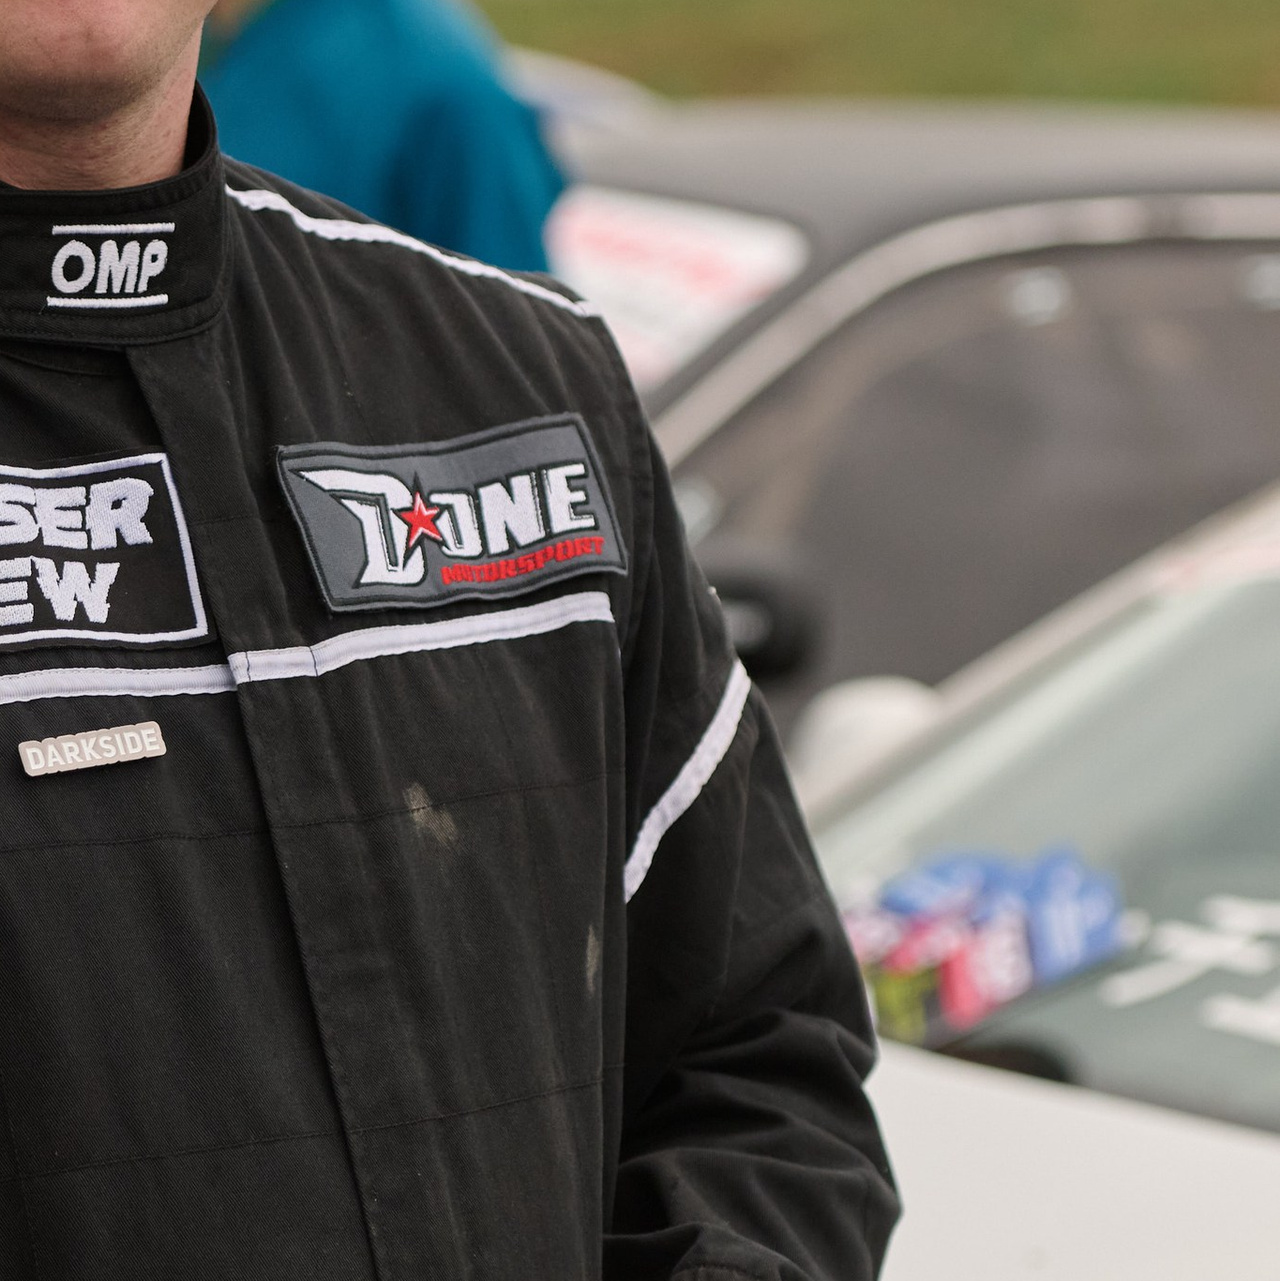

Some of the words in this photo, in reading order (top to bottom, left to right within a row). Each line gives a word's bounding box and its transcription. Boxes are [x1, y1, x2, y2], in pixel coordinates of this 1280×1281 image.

[51, 239, 168, 293] OMP
[440, 535, 605, 586] MOTORSPORT
[26, 727, 161, 770] DARKSIDE
